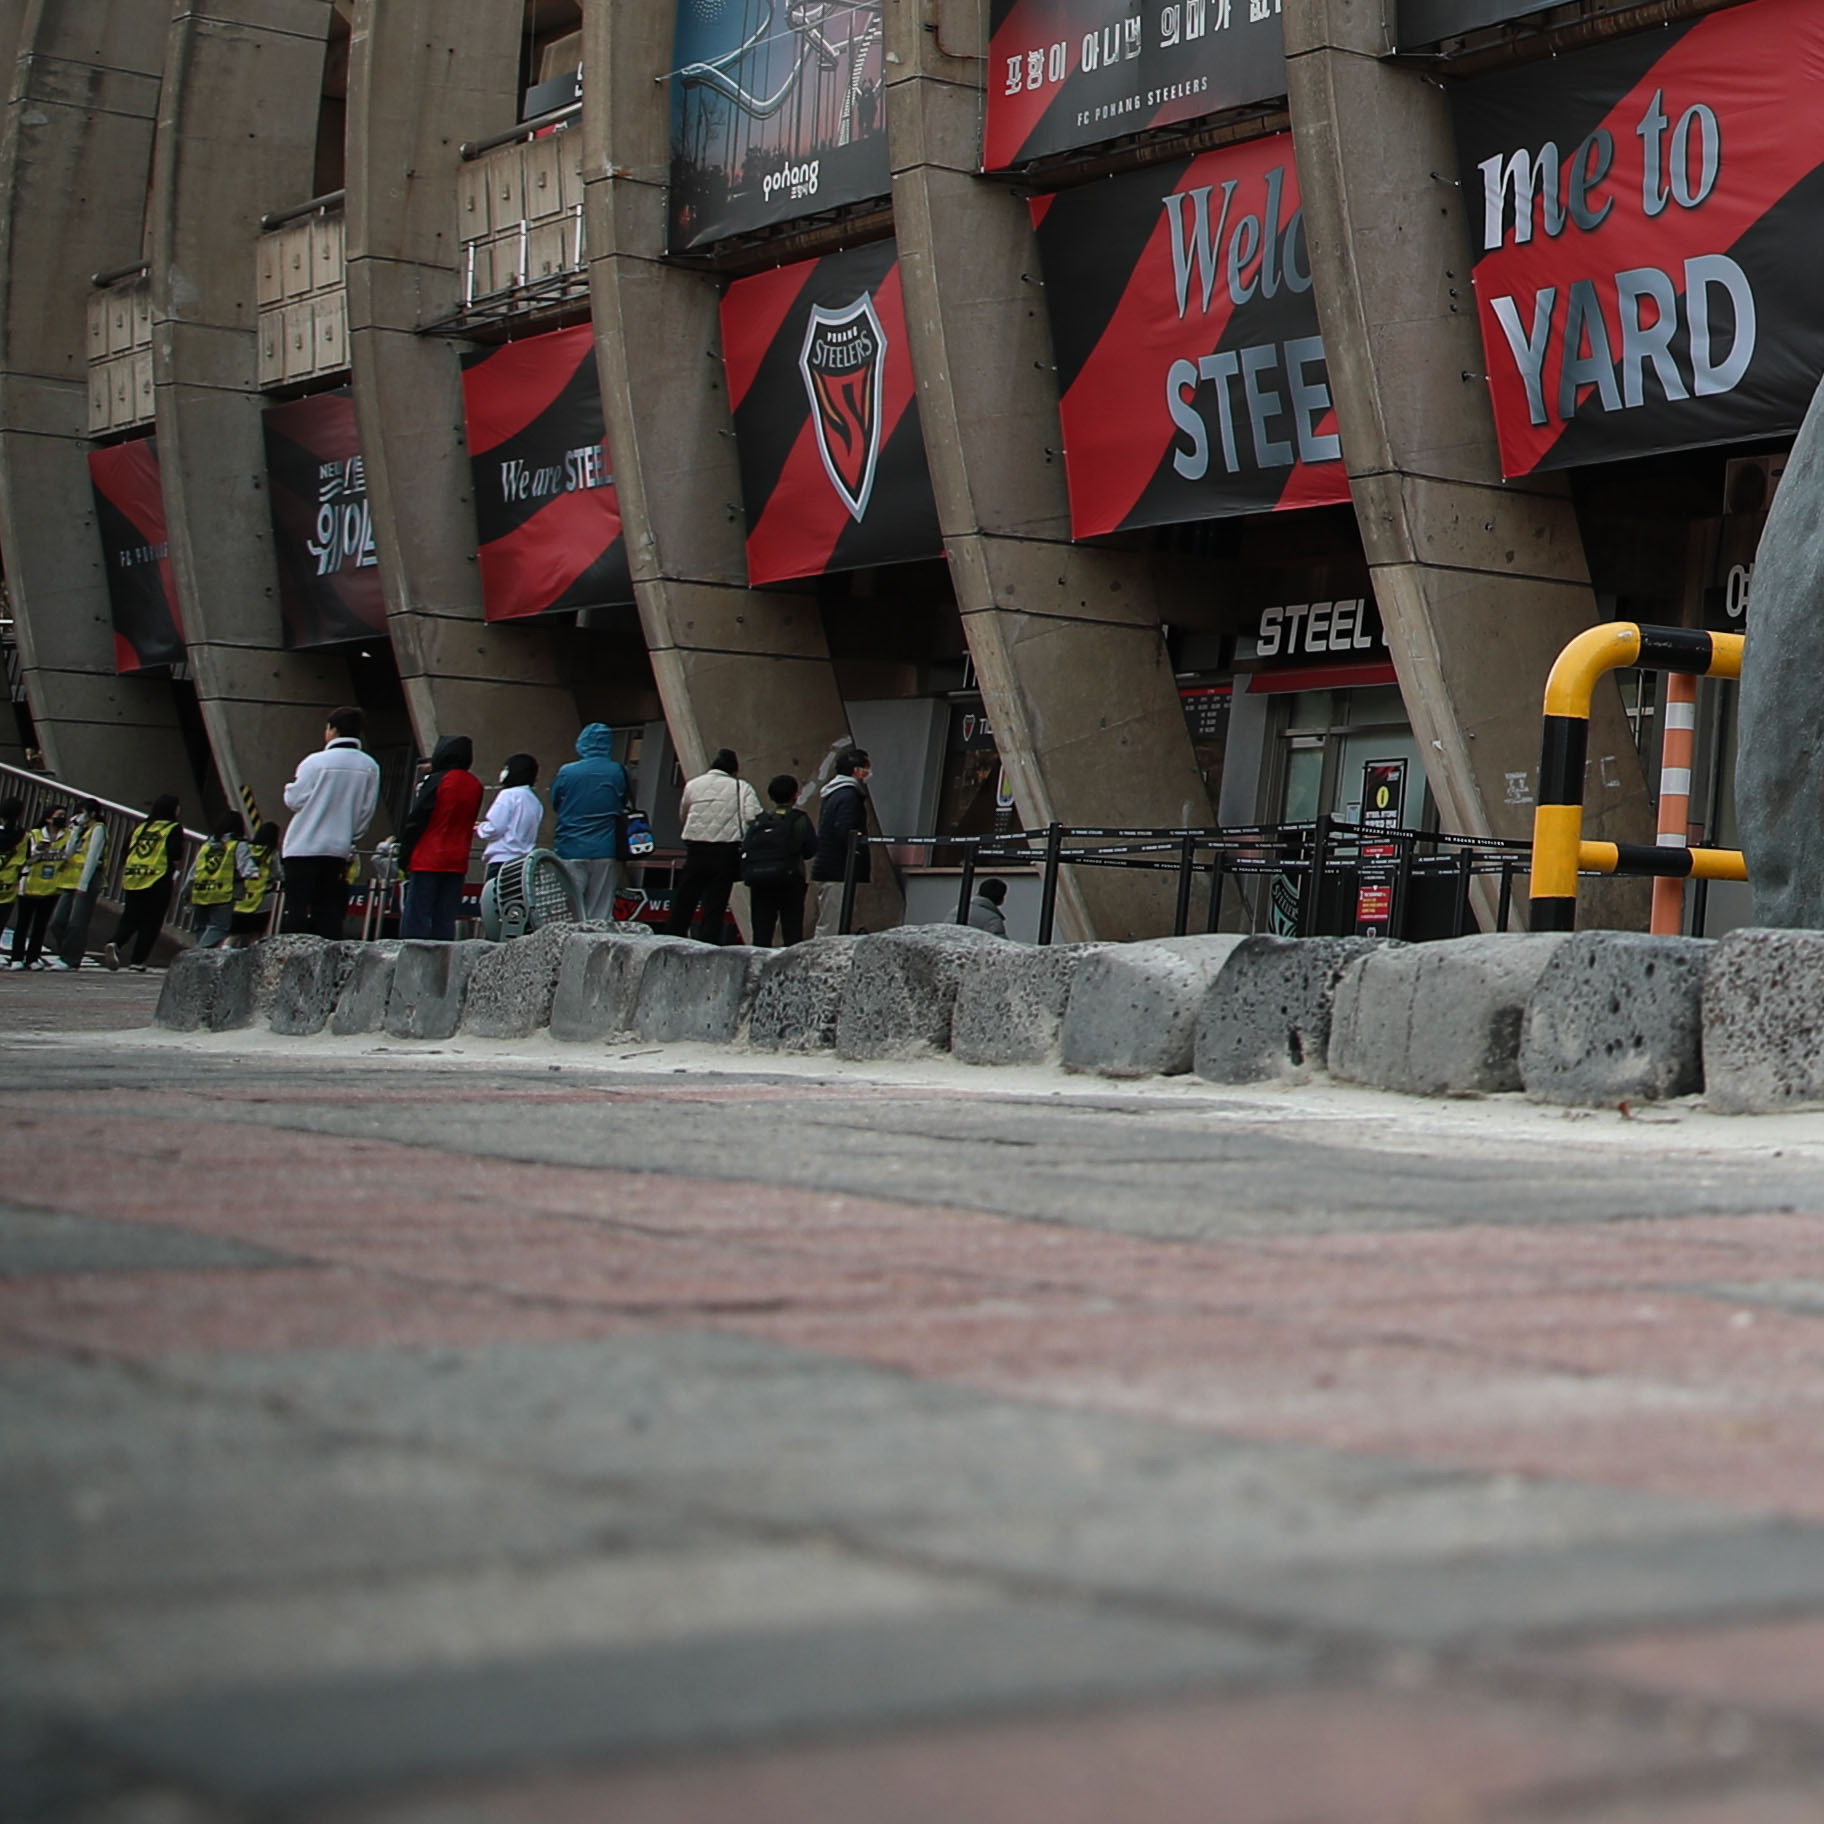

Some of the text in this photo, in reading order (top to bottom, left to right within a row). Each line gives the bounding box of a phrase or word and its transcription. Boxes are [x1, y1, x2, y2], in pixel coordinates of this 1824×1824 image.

[1004, 40, 1068, 98] 포항이
[1081, 14, 1142, 75] 아니면
[1076, 75, 1210, 128] FC POHANG STEELERS
[763, 160, 820, 202] pohang
[1477, 88, 1720, 250] me to
[812, 330, 873, 369] STEELERS
[1490, 253, 1757, 426] YARD
[500, 459, 529, 503] We
[532, 463, 562, 498] are
[1256, 598, 1373, 657] STEEL
